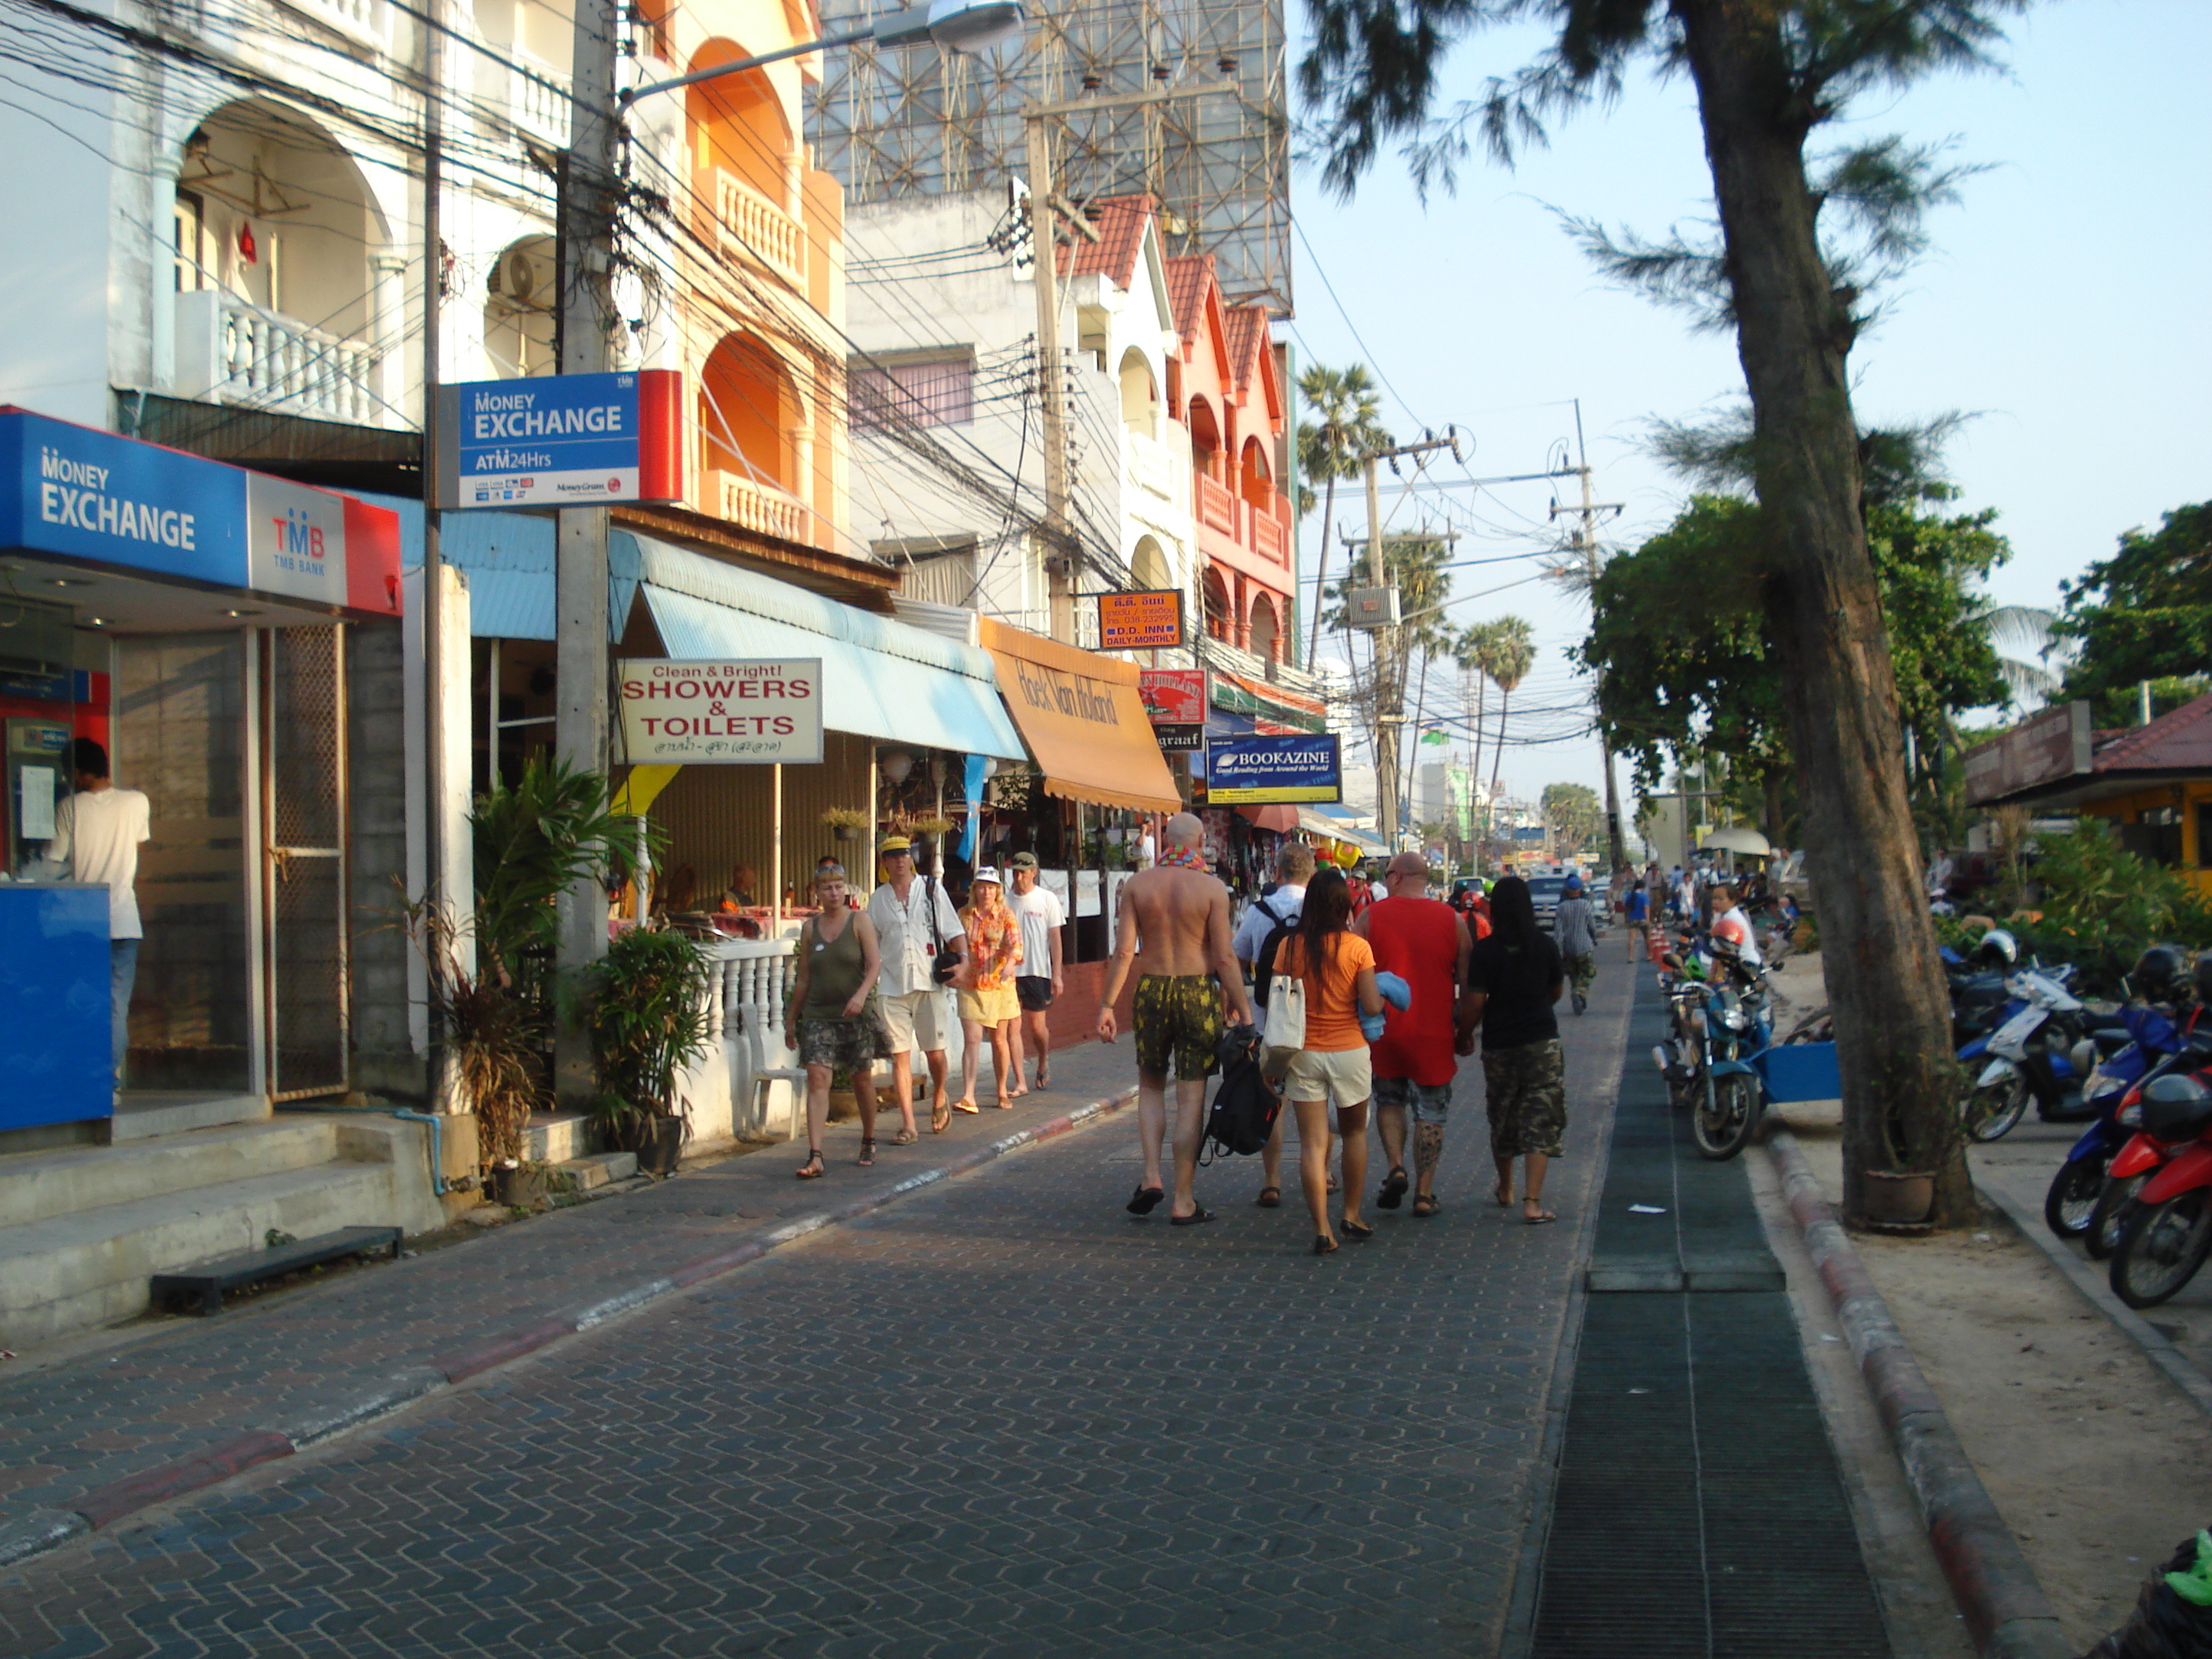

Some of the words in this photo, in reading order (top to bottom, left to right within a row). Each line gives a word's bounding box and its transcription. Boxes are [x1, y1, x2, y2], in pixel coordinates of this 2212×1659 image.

[475, 392, 536, 413] MONEY
[475, 405, 622, 439] EXCHANGE
[41, 446, 109, 490] MONEY
[41, 482, 196, 551] EXCHANGE
[271, 507, 325, 559] TMB
[274, 554, 295, 570] TMB
[299, 559, 325, 577] BANK
[1107, 634, 1176, 645] DAILY-MONTHLY
[1117, 626, 1140, 635] D.D.
[1145, 625, 1164, 634] INN
[652, 665, 701, 678] Clean
[706, 665, 718, 677] &
[724, 665, 782, 679] Bright!
[623, 680, 811, 700] SHOWERS
[1015, 659, 1056, 713] Hoek
[1045, 668, 1079, 717] Van
[1074, 674, 1120, 726] Holland
[1154, 674, 1202, 700] HOLLAND
[709, 701, 727, 716] &
[641, 716, 795, 736] TOILETS
[1238, 752, 1330, 765] BOOKAZINE
